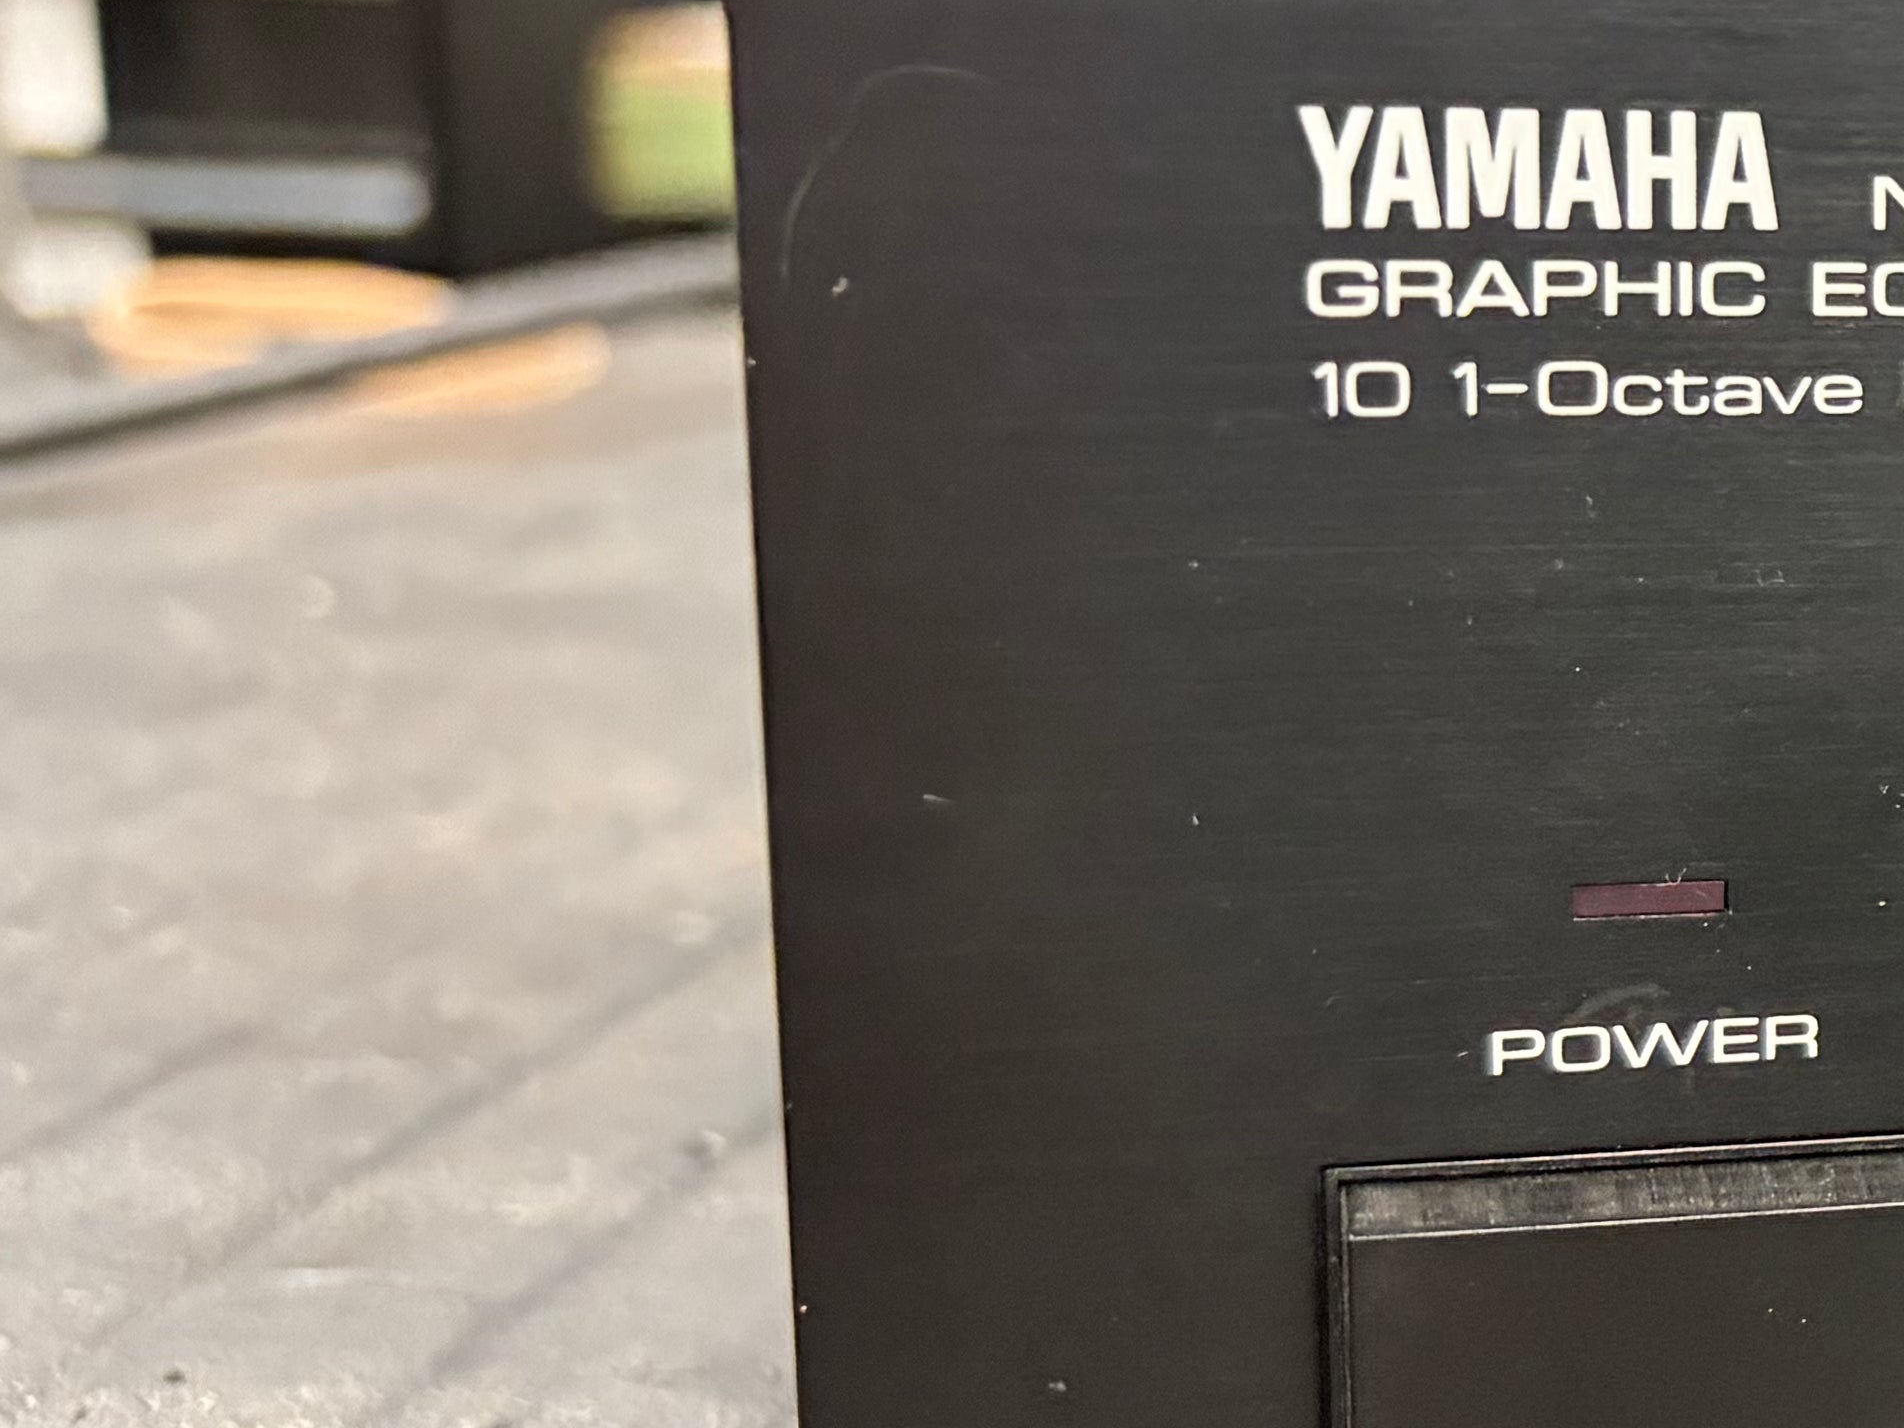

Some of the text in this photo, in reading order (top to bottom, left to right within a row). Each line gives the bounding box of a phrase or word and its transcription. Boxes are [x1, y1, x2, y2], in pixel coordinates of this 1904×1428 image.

[1297, 103, 1780, 232] YAMAHA
[1304, 258, 1767, 319] GRAPHIC
[1311, 359, 1412, 419] 10
[1451, 359, 1865, 418] 1-Octave
[1487, 1013, 1820, 1077] POWER
